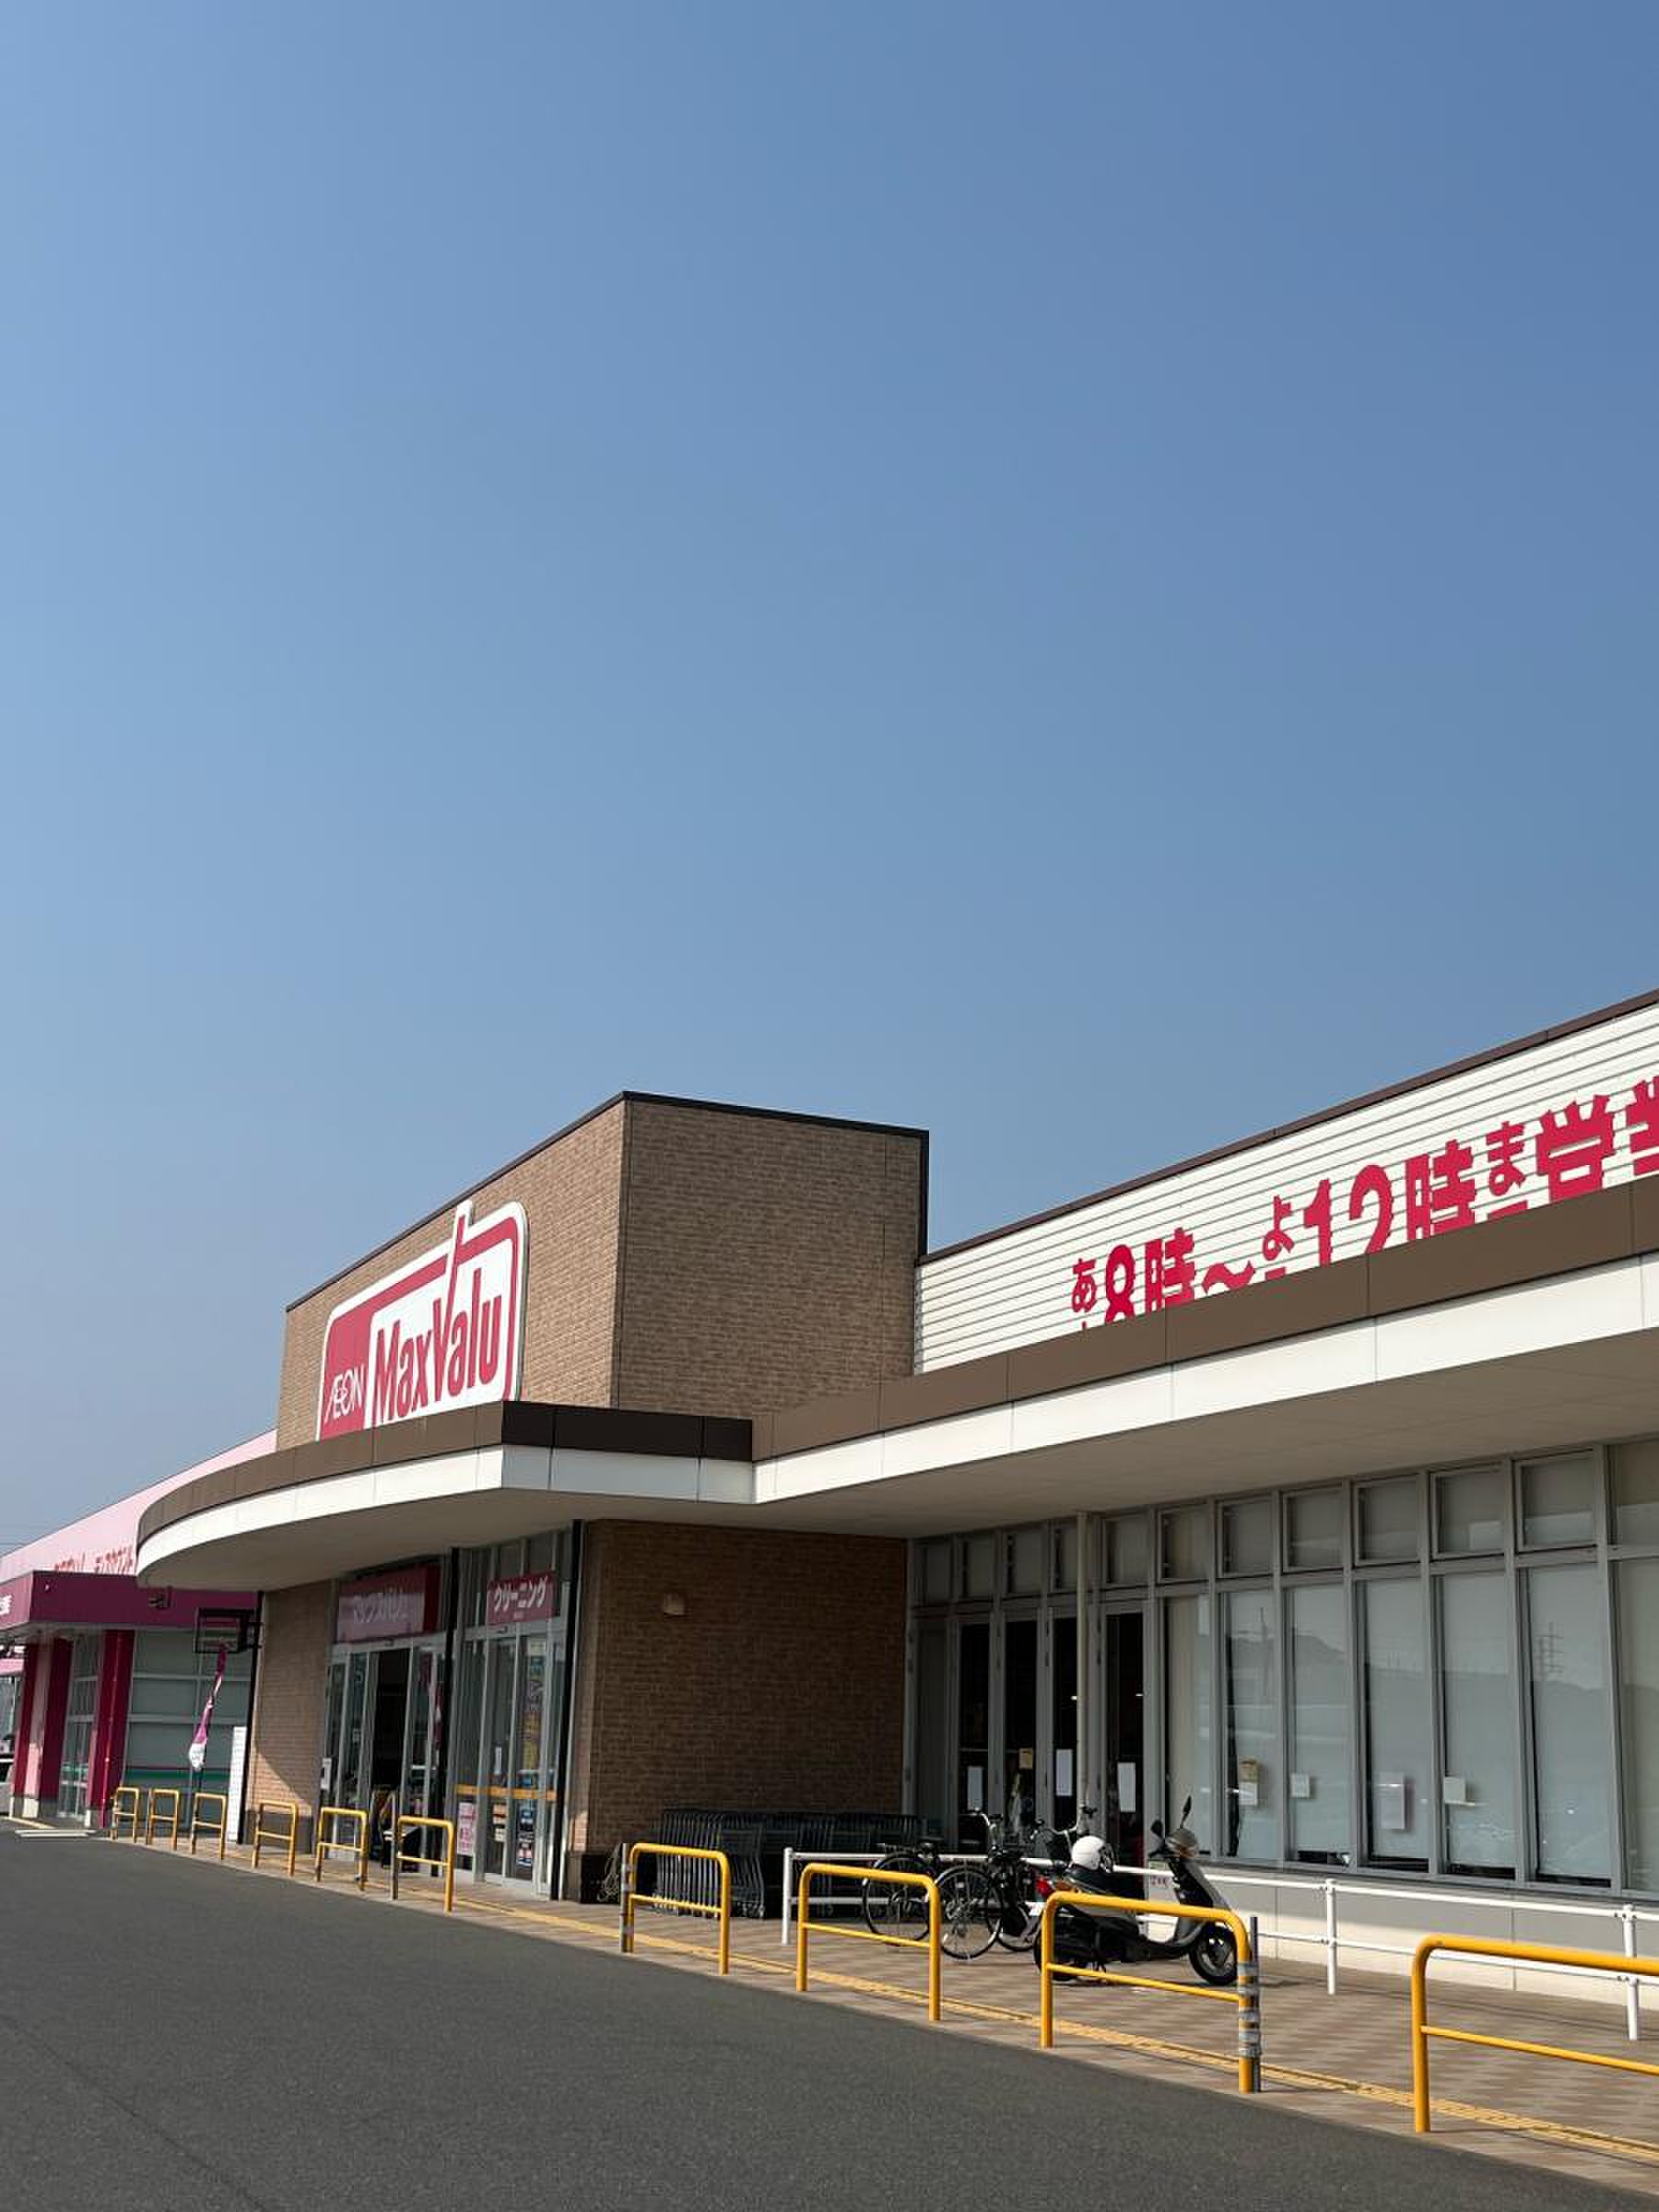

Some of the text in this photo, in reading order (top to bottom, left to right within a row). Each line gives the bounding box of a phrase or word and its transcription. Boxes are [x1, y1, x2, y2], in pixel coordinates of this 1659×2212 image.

[373, 1214, 502, 1427] MaxValu
[493, 1574, 548, 1613] クリーニング
